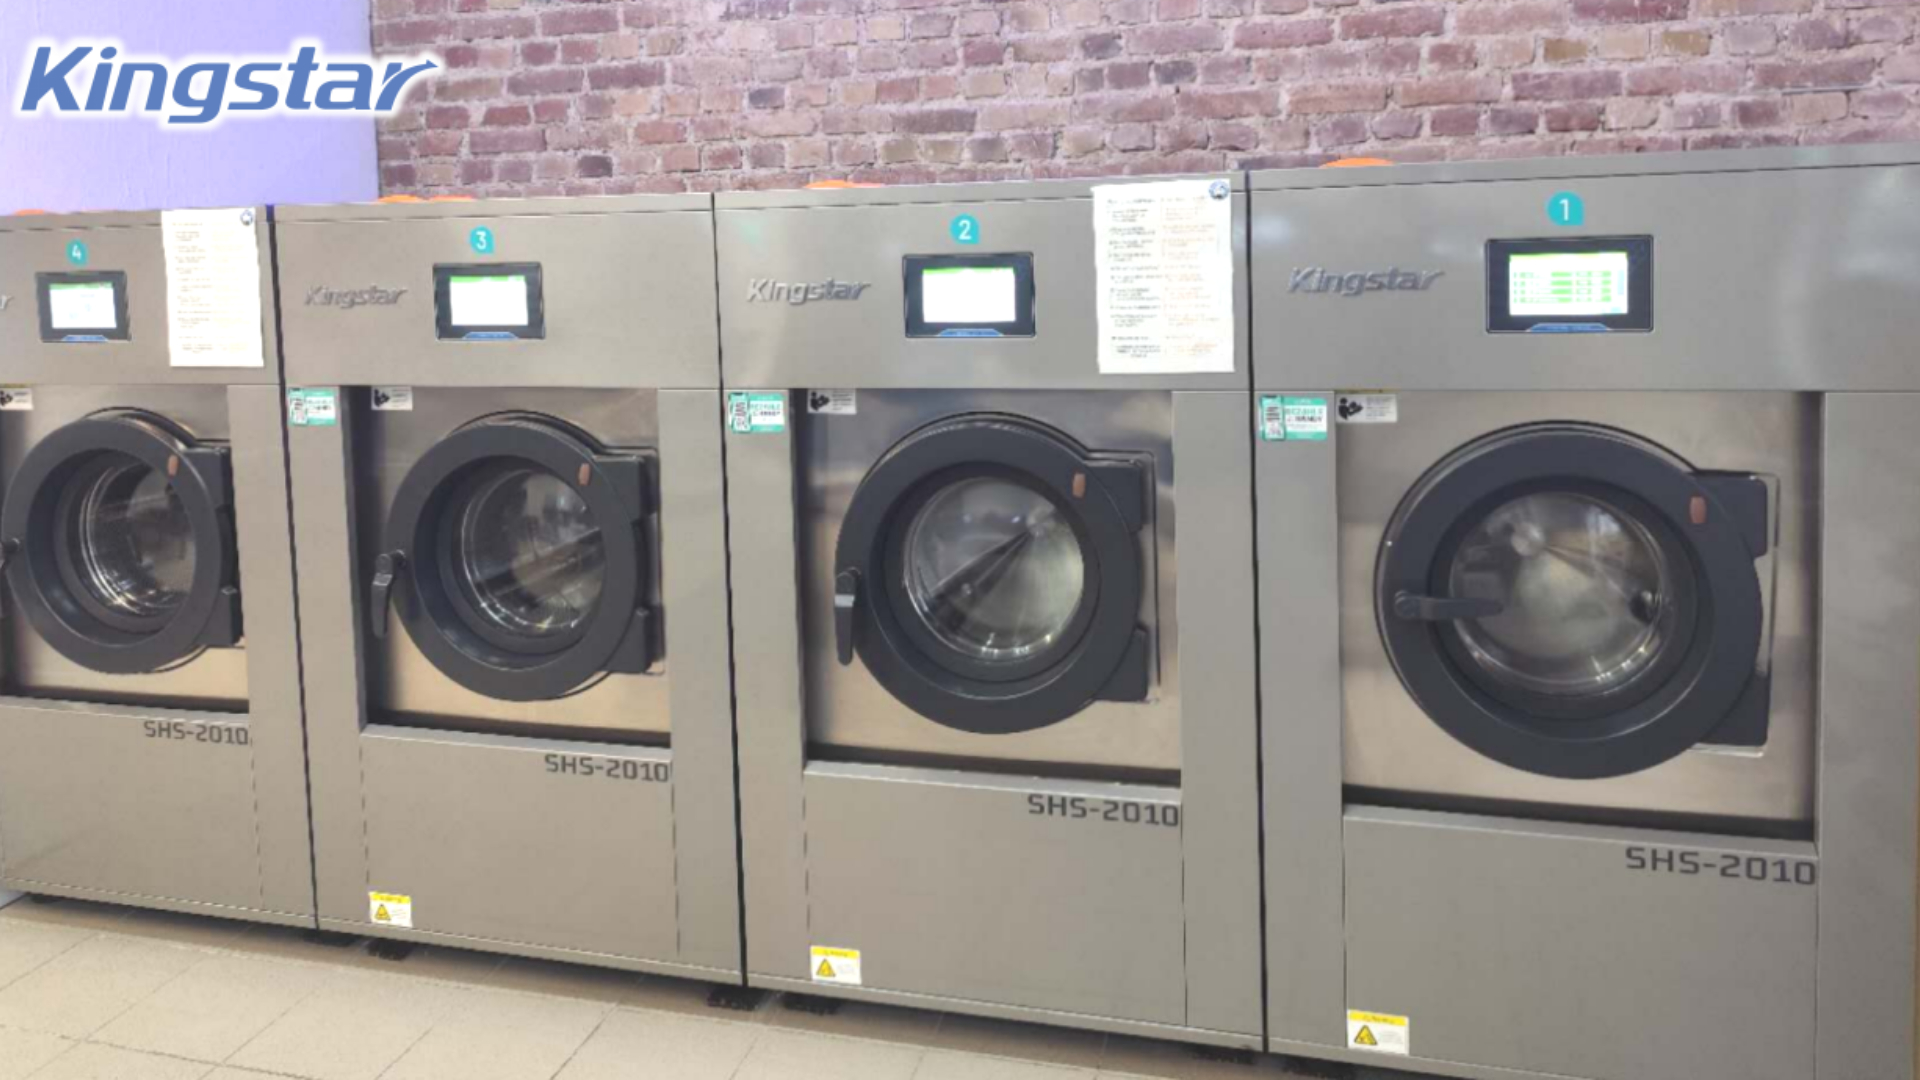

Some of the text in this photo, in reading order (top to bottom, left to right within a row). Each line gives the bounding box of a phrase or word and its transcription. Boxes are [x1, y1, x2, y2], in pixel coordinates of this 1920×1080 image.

[1559, 199, 1569, 221] 1
[476, 231, 486, 250] 3
[958, 220, 971, 239] 2
[71, 245, 82, 260] 4
[746, 278, 871, 305] Kingstar
[1288, 267, 1445, 295] Kingstar
[304, 286, 408, 308] Kingstar
[143, 720, 248, 745] SHS-2010
[544, 753, 669, 783] SHS-2010
[1027, 793, 1180, 827] SHS-2010
[1625, 846, 1816, 885] SHS-2010
